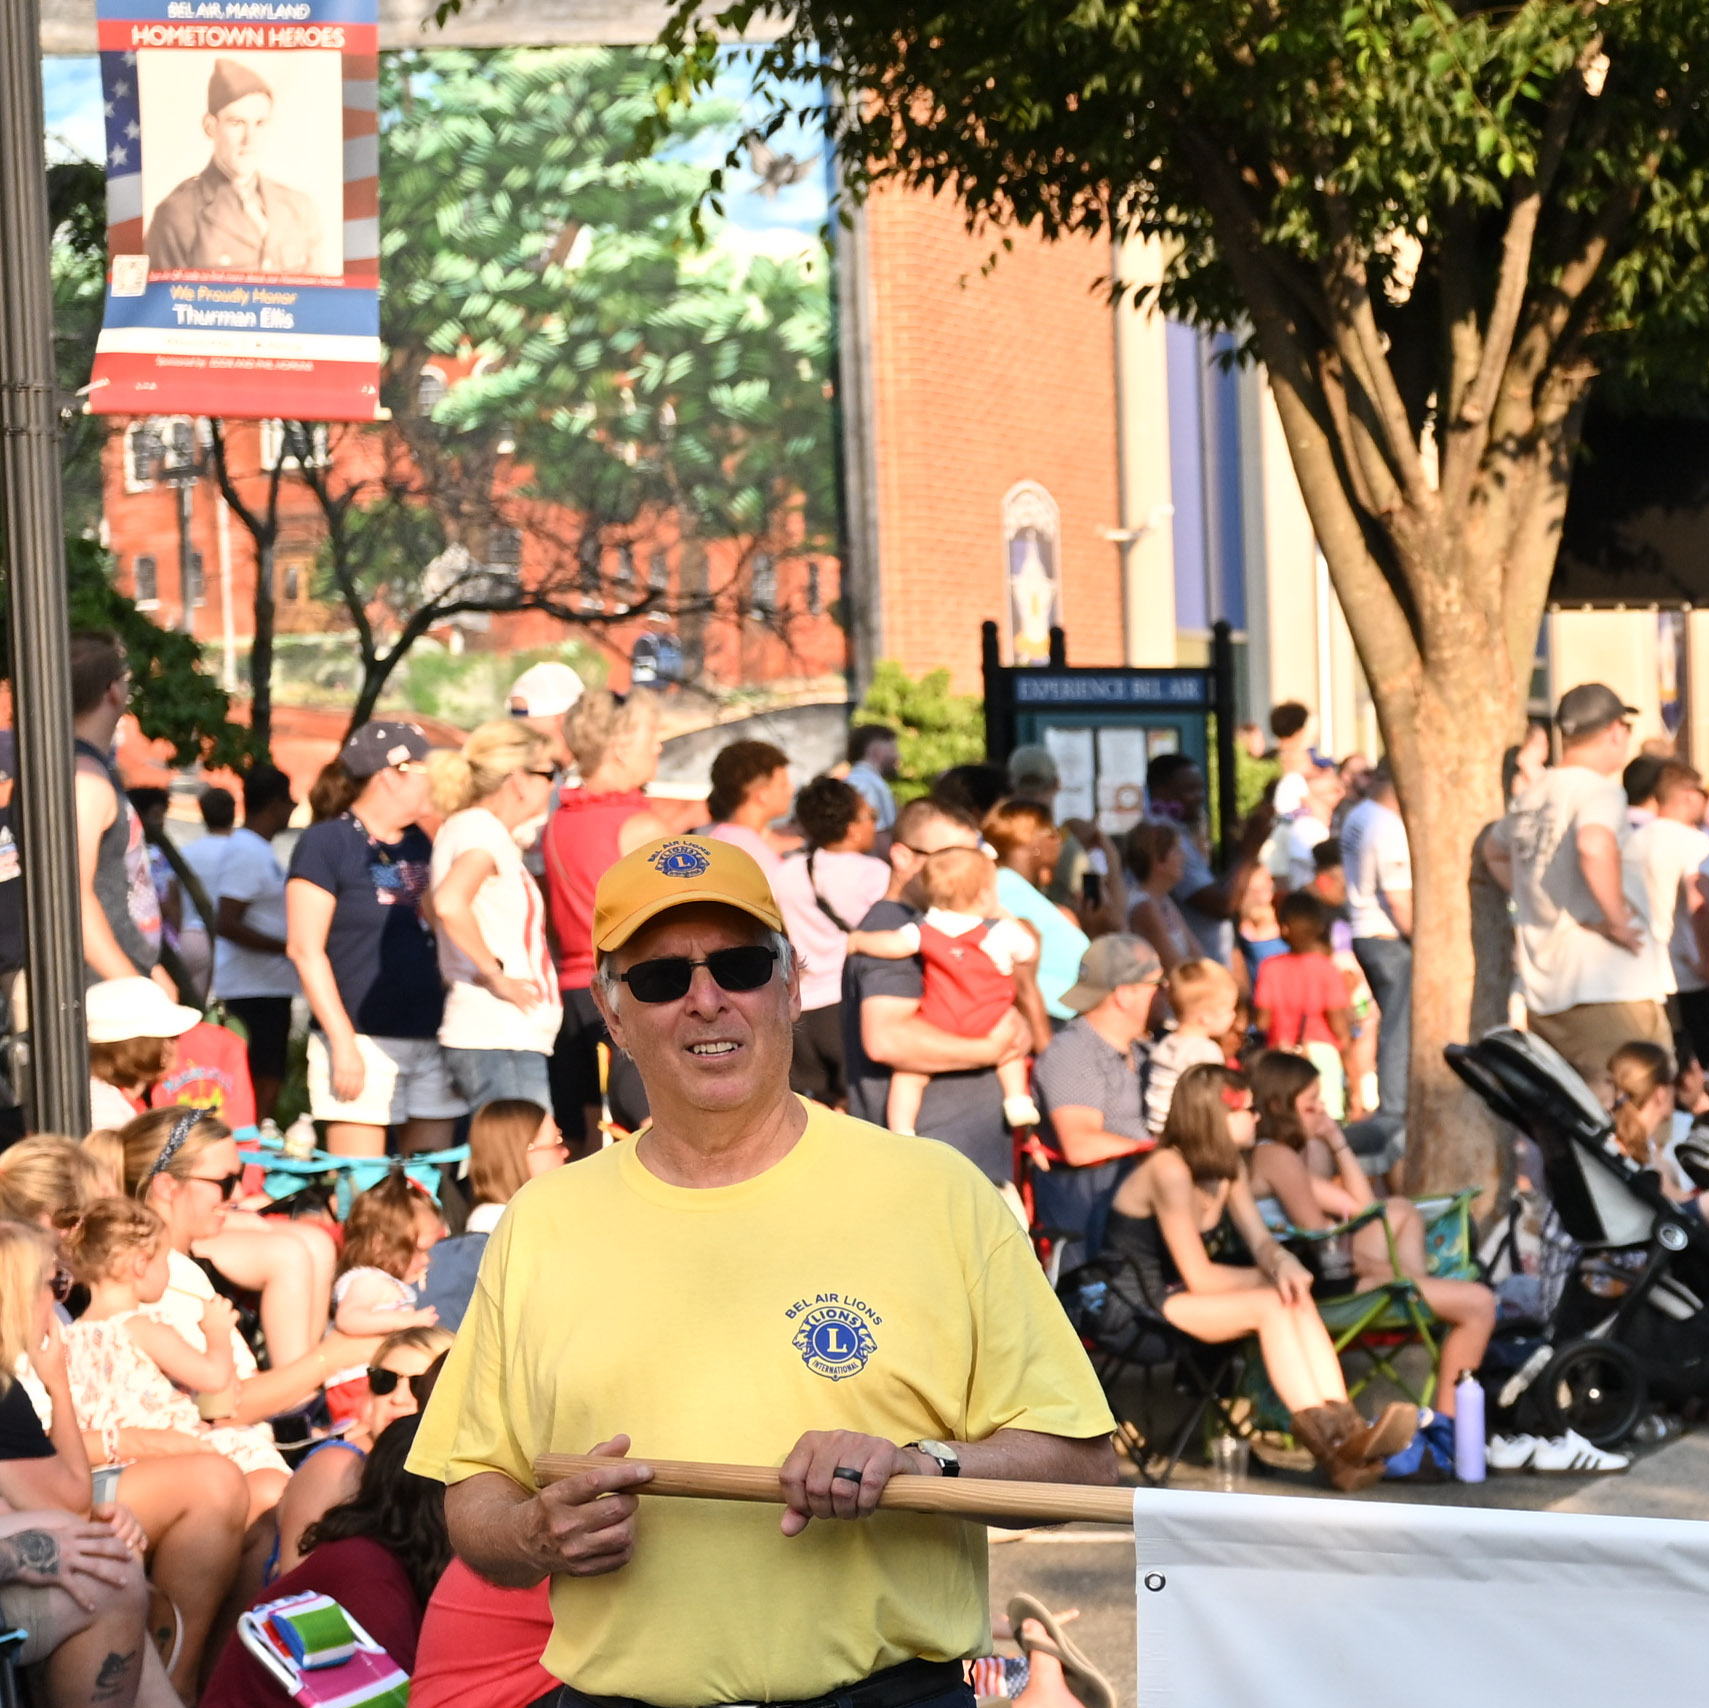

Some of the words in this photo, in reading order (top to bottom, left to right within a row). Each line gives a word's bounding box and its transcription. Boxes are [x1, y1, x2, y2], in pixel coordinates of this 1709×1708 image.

[168, 2, 198, 19] BEL
[225, 2, 310, 20] MARYLAND
[132, 24, 265, 47] HOMETOWN
[269, 25, 345, 48] HEROES
[170, 285, 196, 301] We
[252, 288, 298, 305] Honor
[172, 304, 257, 328] Thurman
[260, 307, 295, 329] Ellis
[1020, 677, 1127, 698] EXPERIENCE
[676, 855, 691, 867] L
[785, 1299, 813, 1320] BEL
[815, 1293, 839, 1304] AIR
[843, 1295, 883, 1326] LIONS
[811, 1309, 860, 1327] LIONS
[826, 1328, 848, 1353] L
[812, 1359, 859, 1375] INTERNATIONAL
